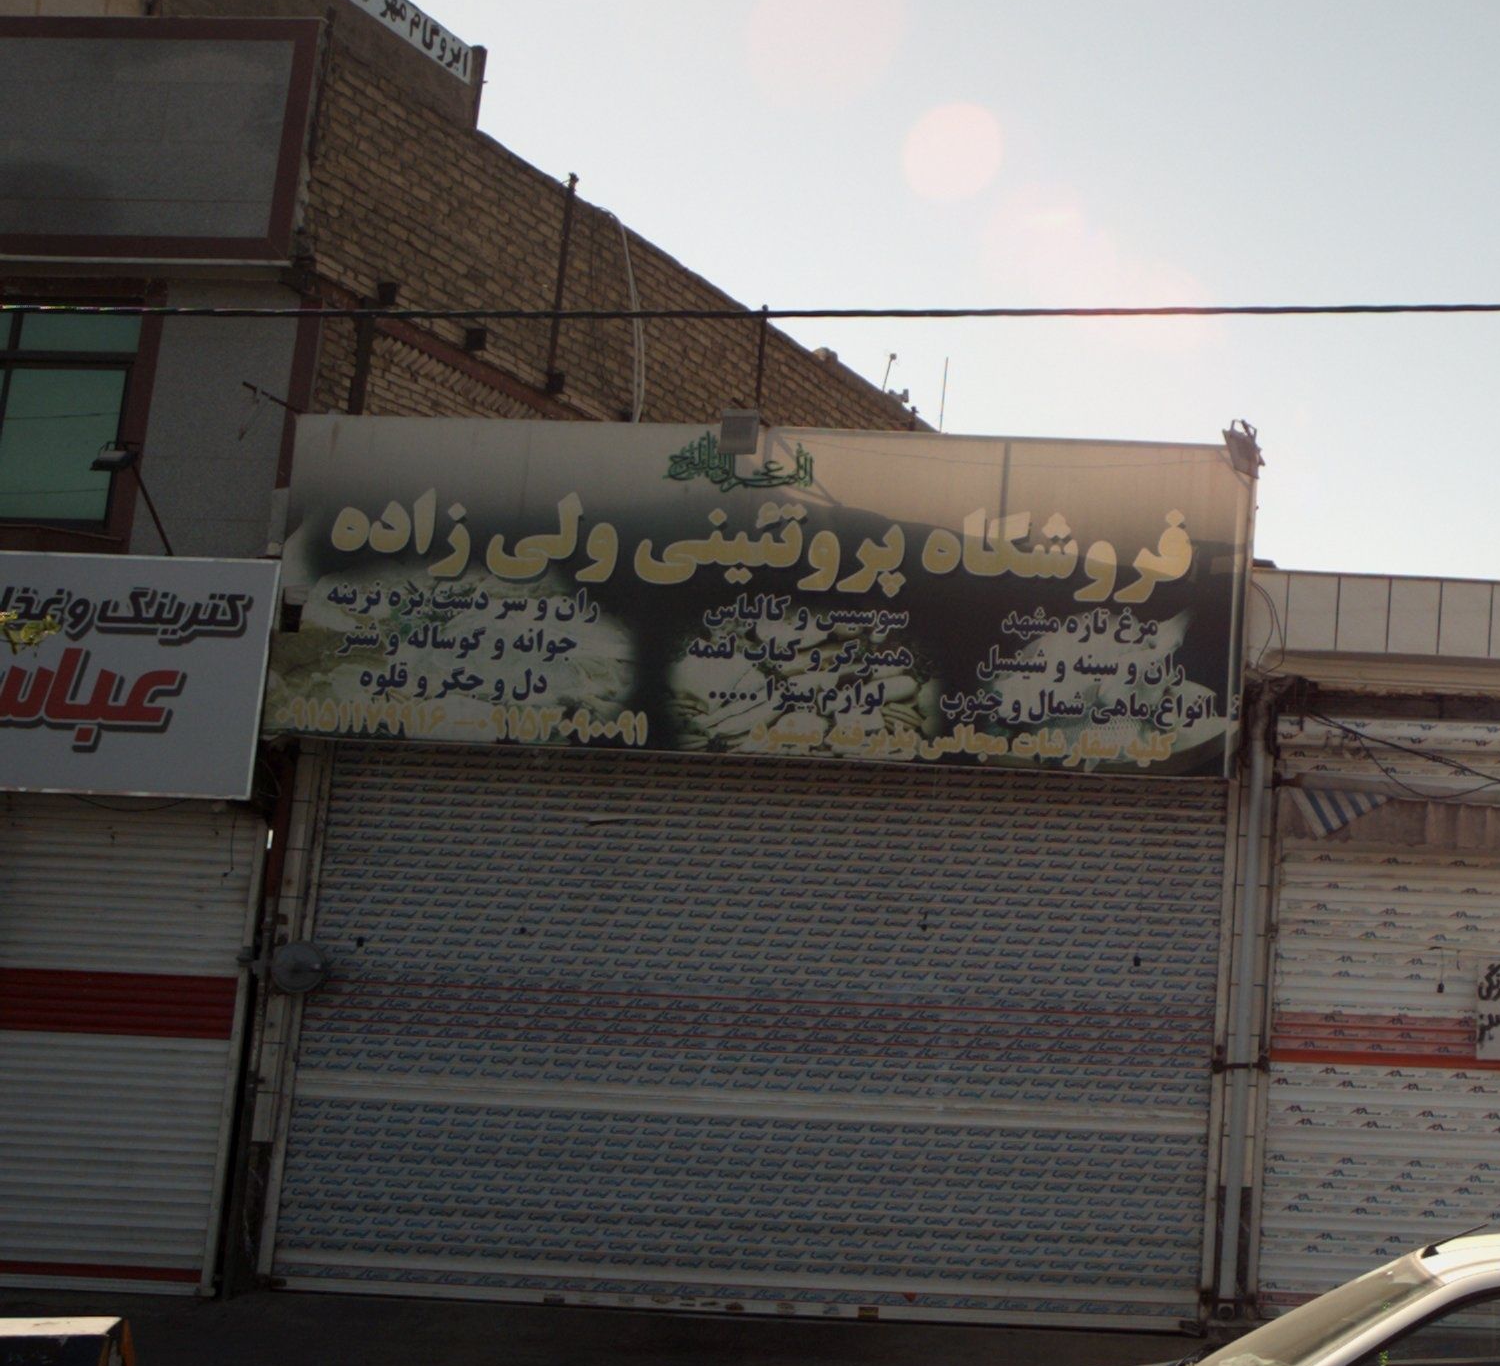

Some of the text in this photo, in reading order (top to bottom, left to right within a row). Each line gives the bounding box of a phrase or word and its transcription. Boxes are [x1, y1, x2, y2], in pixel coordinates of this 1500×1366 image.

[331, 487, 1193, 603] فروشگاه پروتئینی ولی زاده
[67, 593, 97, 640] و
[97, 586, 252, 641] کترینگ
[326, 582, 600, 624] ران و سر دست بره نرینه
[703, 592, 910, 634] سوسیس و کالباس
[336, 622, 579, 663] جوانه و گوساله و شتر
[1001, 606, 1160, 644] مرغ تازه مشهد
[688, 632, 737, 660] لقمه
[743, 635, 801, 670] کباب
[806, 648, 822, 673] و
[359, 661, 548, 701] دل و جگر و قلوه
[1052, 656, 1067, 683] و
[1073, 653, 1119, 682] سینه
[1124, 659, 1139, 685] و
[1143, 651, 1186, 686] ران
[766, 675, 816, 712] پیتزا
[819, 680, 886, 714] لوازم
[940, 687, 1003, 722] جنوب
[1006, 696, 1022, 723] و
[1028, 689, 1084, 724] شمال
[1090, 691, 1149, 724] ماهی
[1153, 693, 1214, 728] انواع
[919, 722, 1008, 762] مجالس
[1011, 726, 1119, 767] سفارشات
[1124, 730, 1178, 768] کلیه
